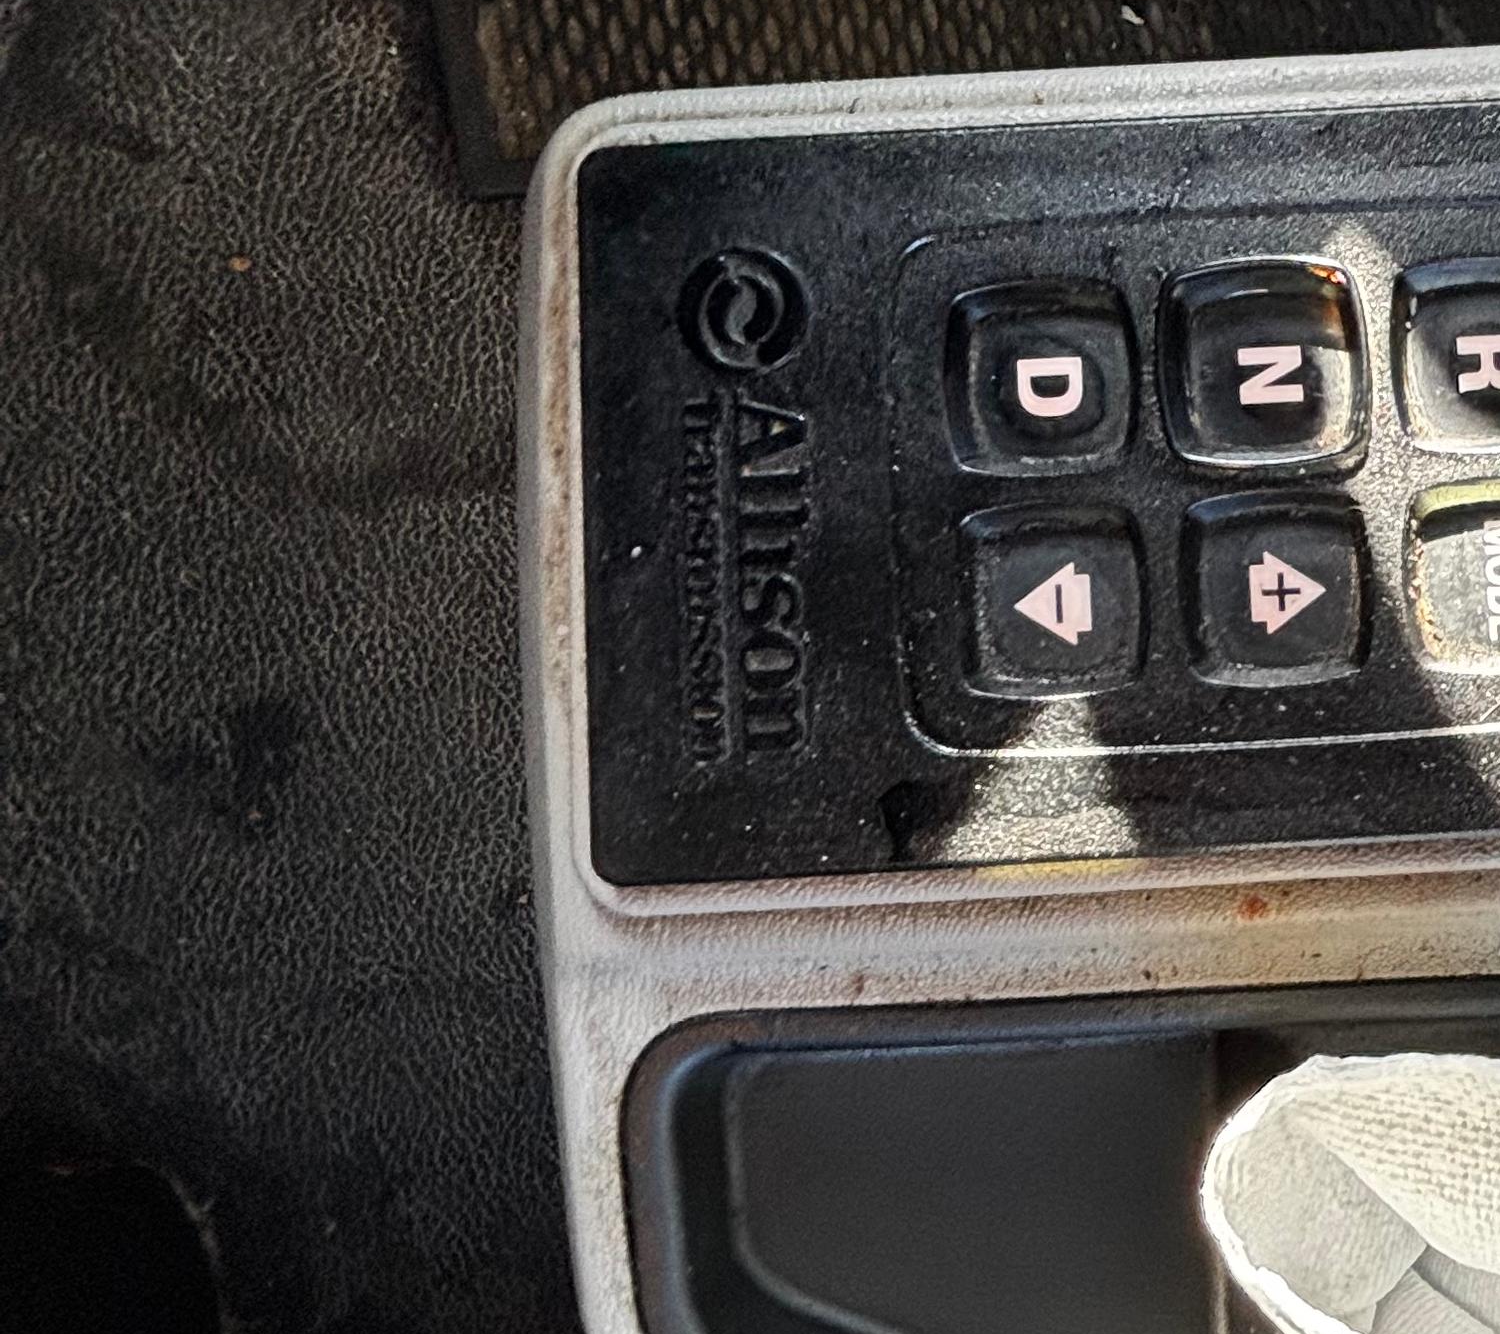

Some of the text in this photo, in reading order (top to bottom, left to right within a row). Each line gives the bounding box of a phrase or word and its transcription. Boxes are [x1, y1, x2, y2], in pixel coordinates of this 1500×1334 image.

[1015, 357, 1085, 417] D
[1237, 346, 1304, 406] N
[735, 390, 809, 760] Allison
